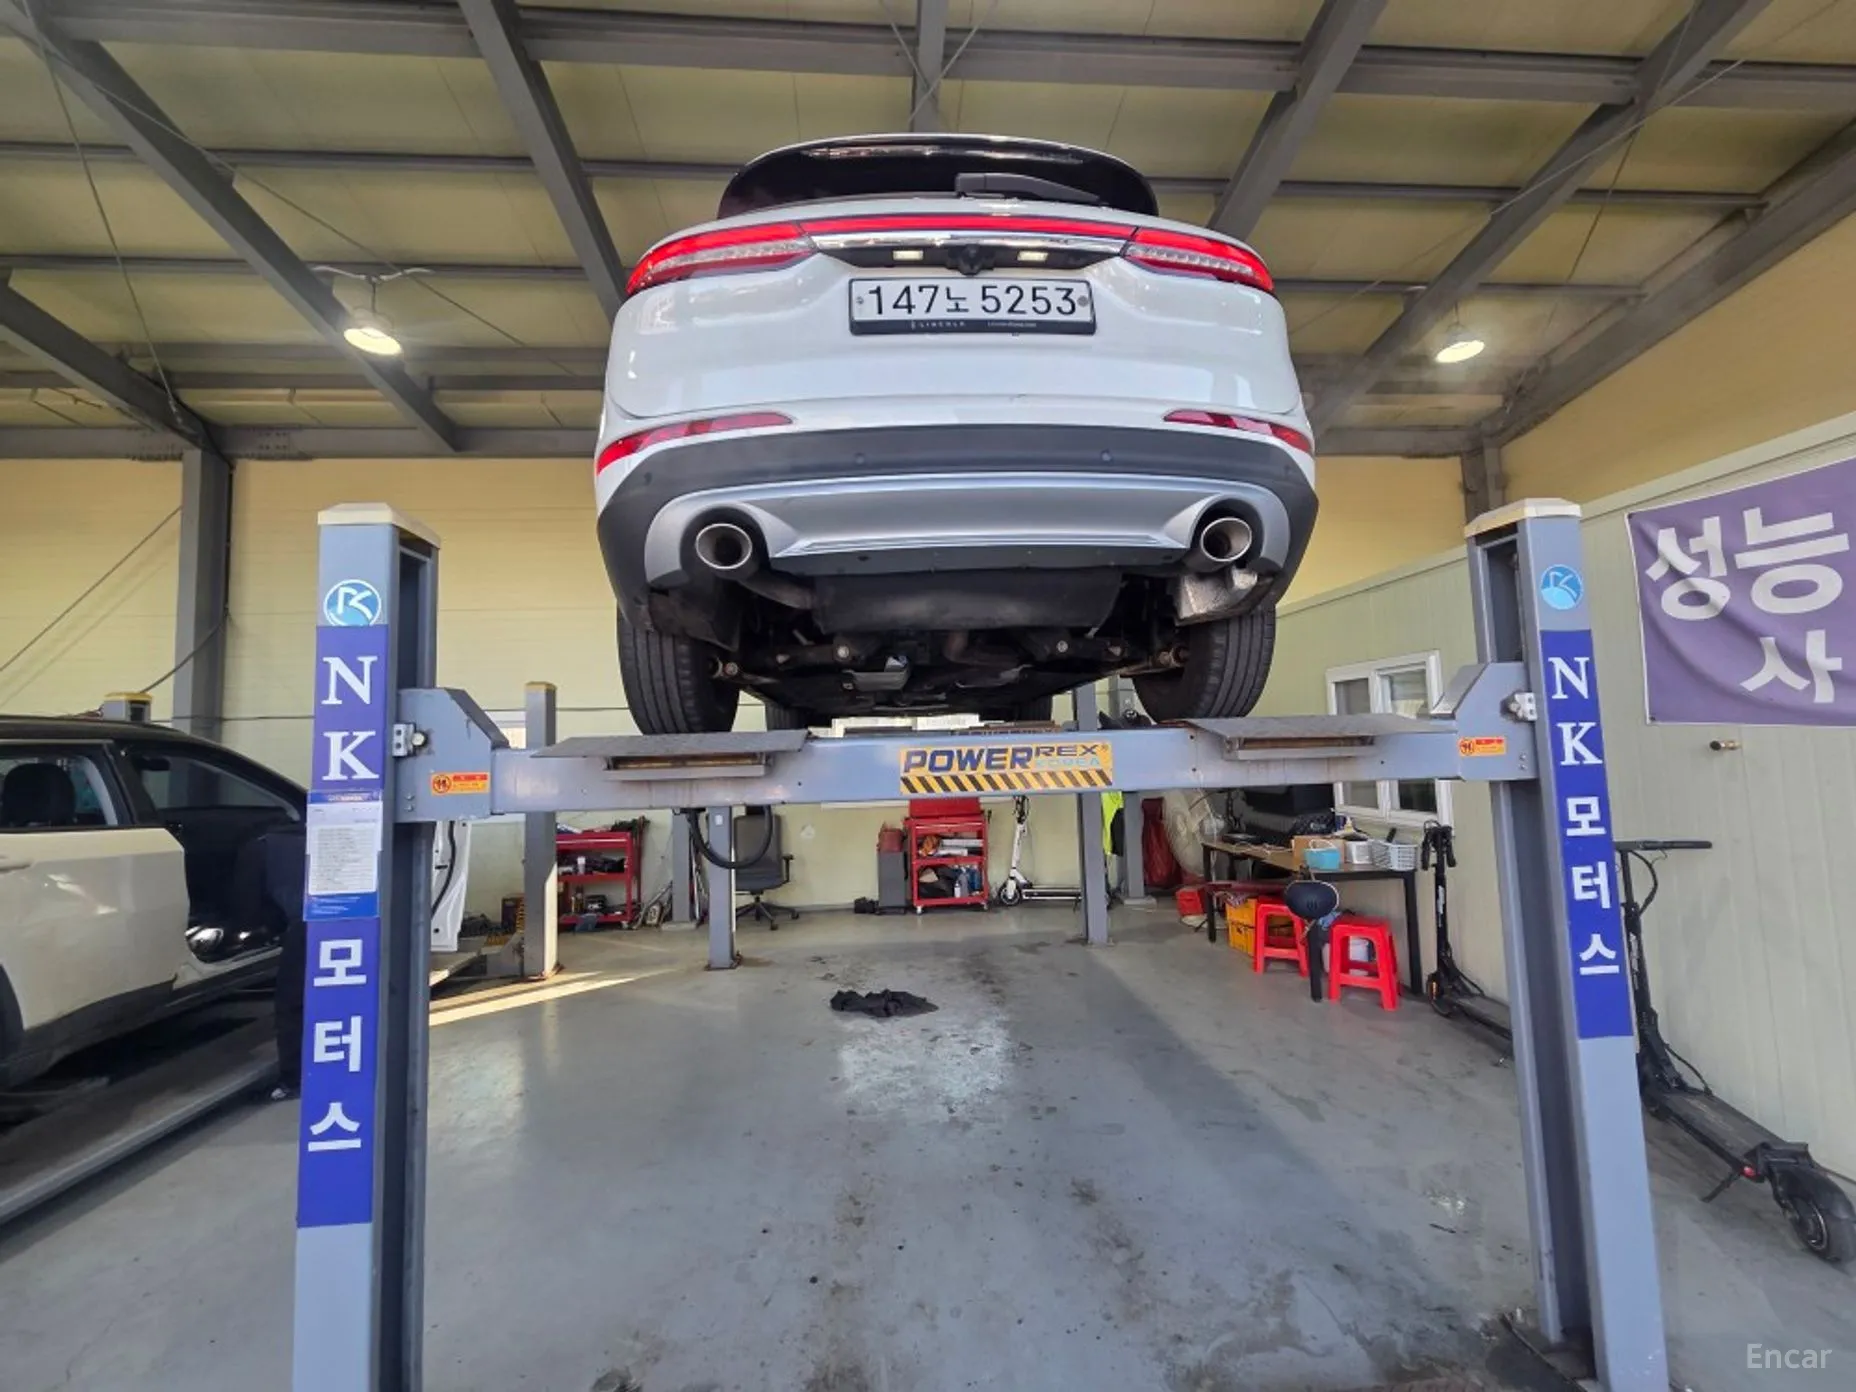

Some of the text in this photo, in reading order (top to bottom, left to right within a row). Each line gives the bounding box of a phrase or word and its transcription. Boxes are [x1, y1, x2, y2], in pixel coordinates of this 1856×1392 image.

[868, 285, 1077, 316] 147노 5253
[1645, 507, 1850, 621] 성능
[1740, 629, 1843, 704] 사
